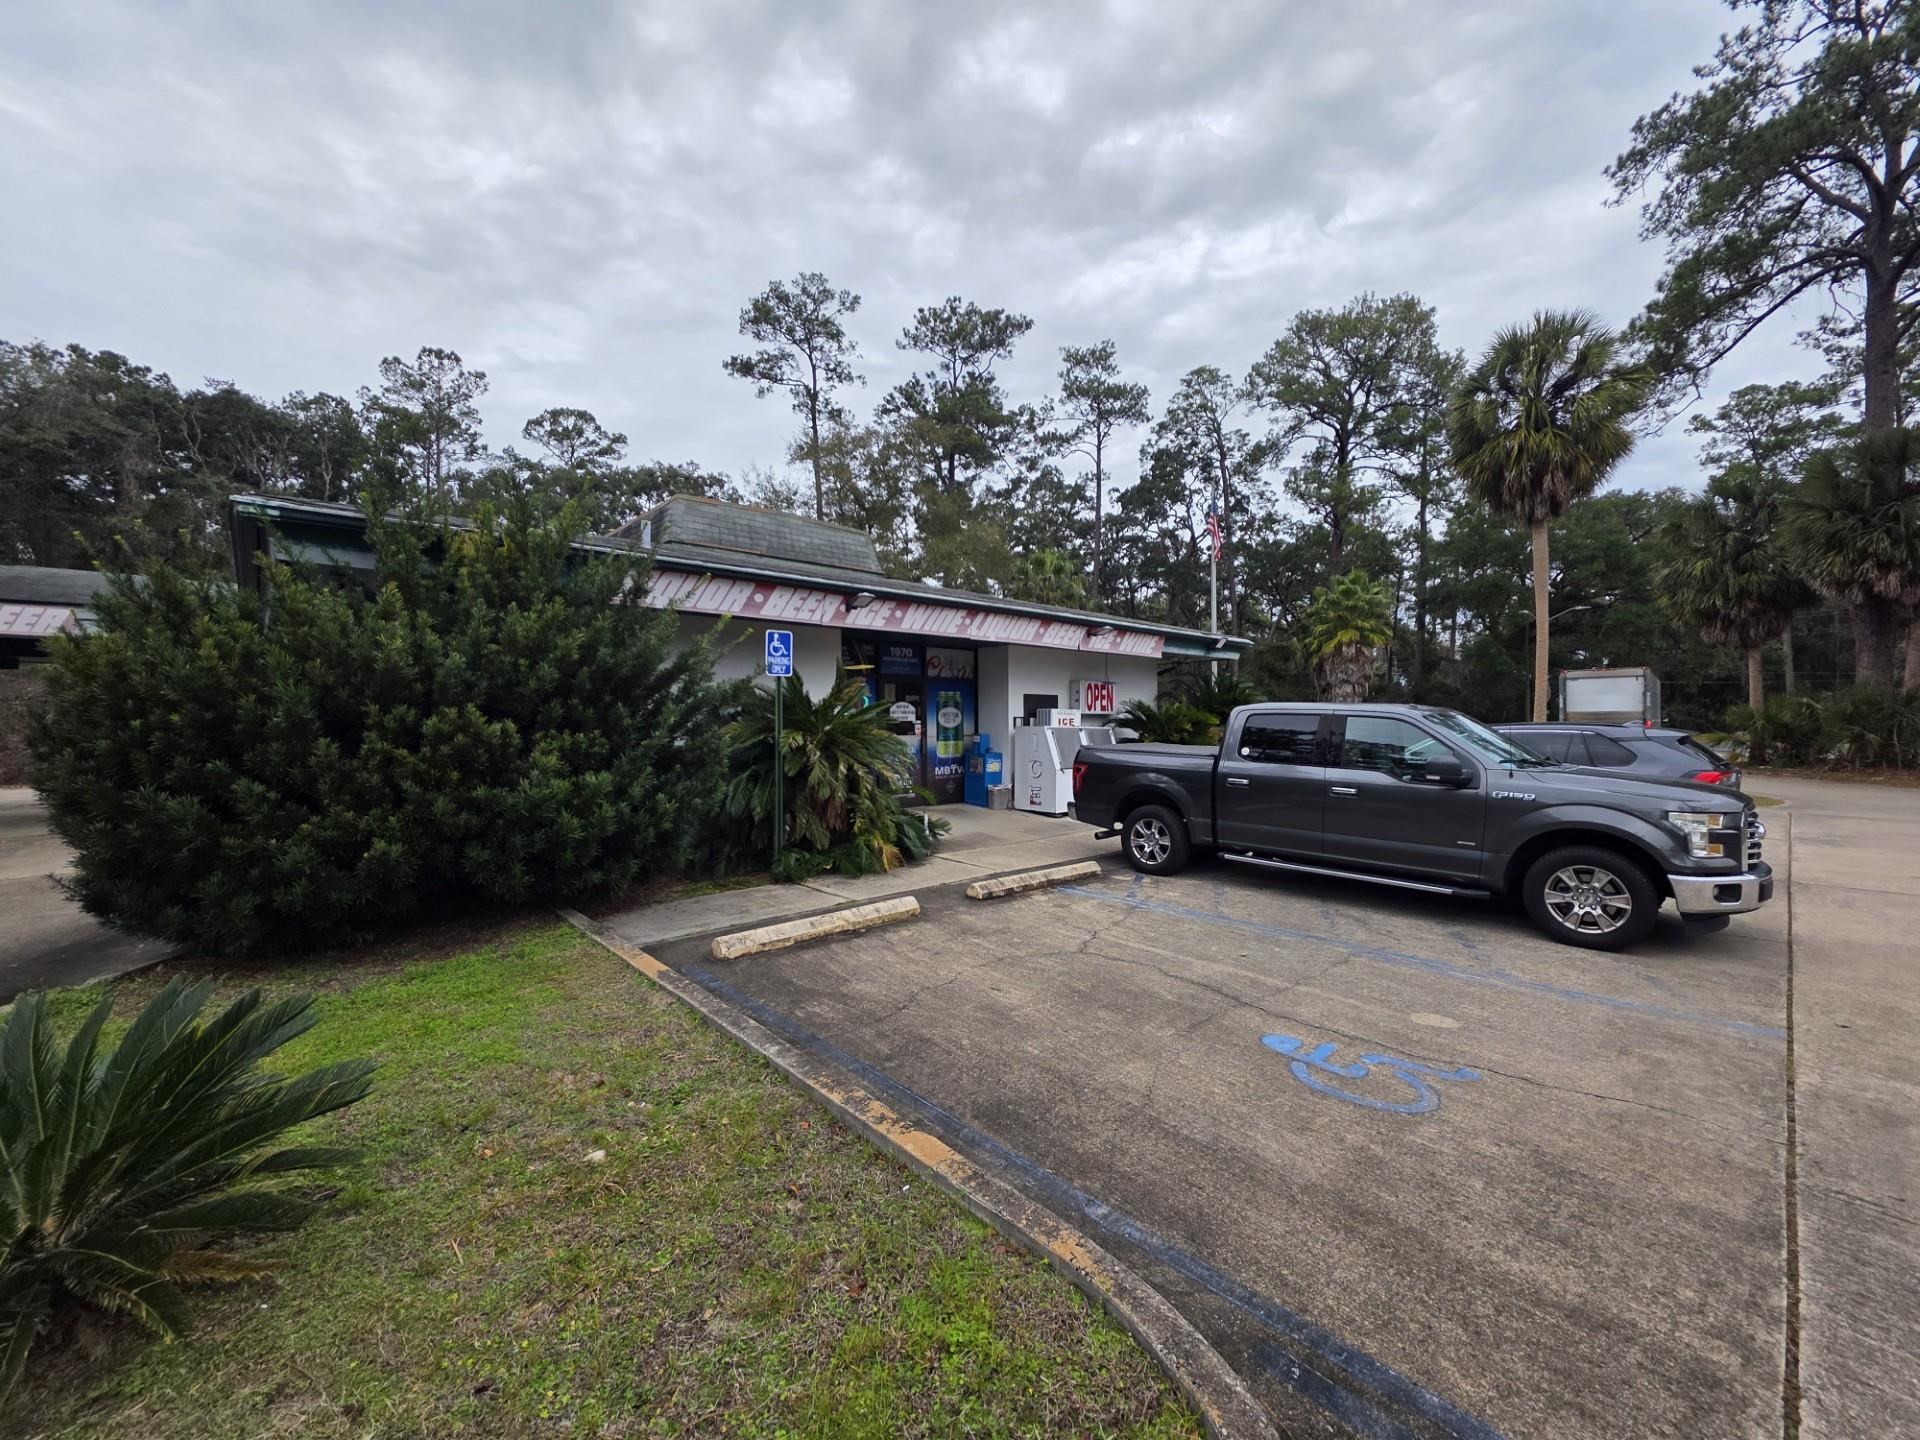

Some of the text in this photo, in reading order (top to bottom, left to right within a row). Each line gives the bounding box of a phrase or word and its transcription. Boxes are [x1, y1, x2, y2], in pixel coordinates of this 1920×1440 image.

[0, 605, 68, 633] EER
[760, 586, 843, 623] BEER
[901, 603, 967, 633] WINE
[968, 611, 1041, 641] LIQUOR
[1041, 622, 1088, 646] BEER
[1119, 632, 1159, 654] WINE
[768, 656, 790, 665] PARKING
[890, 647, 912, 657] 1970
[772, 665, 786, 673] ONLY
[1086, 682, 1114, 712] OPEN
[1058, 718, 1075, 726] ICE
[1029, 733, 1043, 806] ICE
